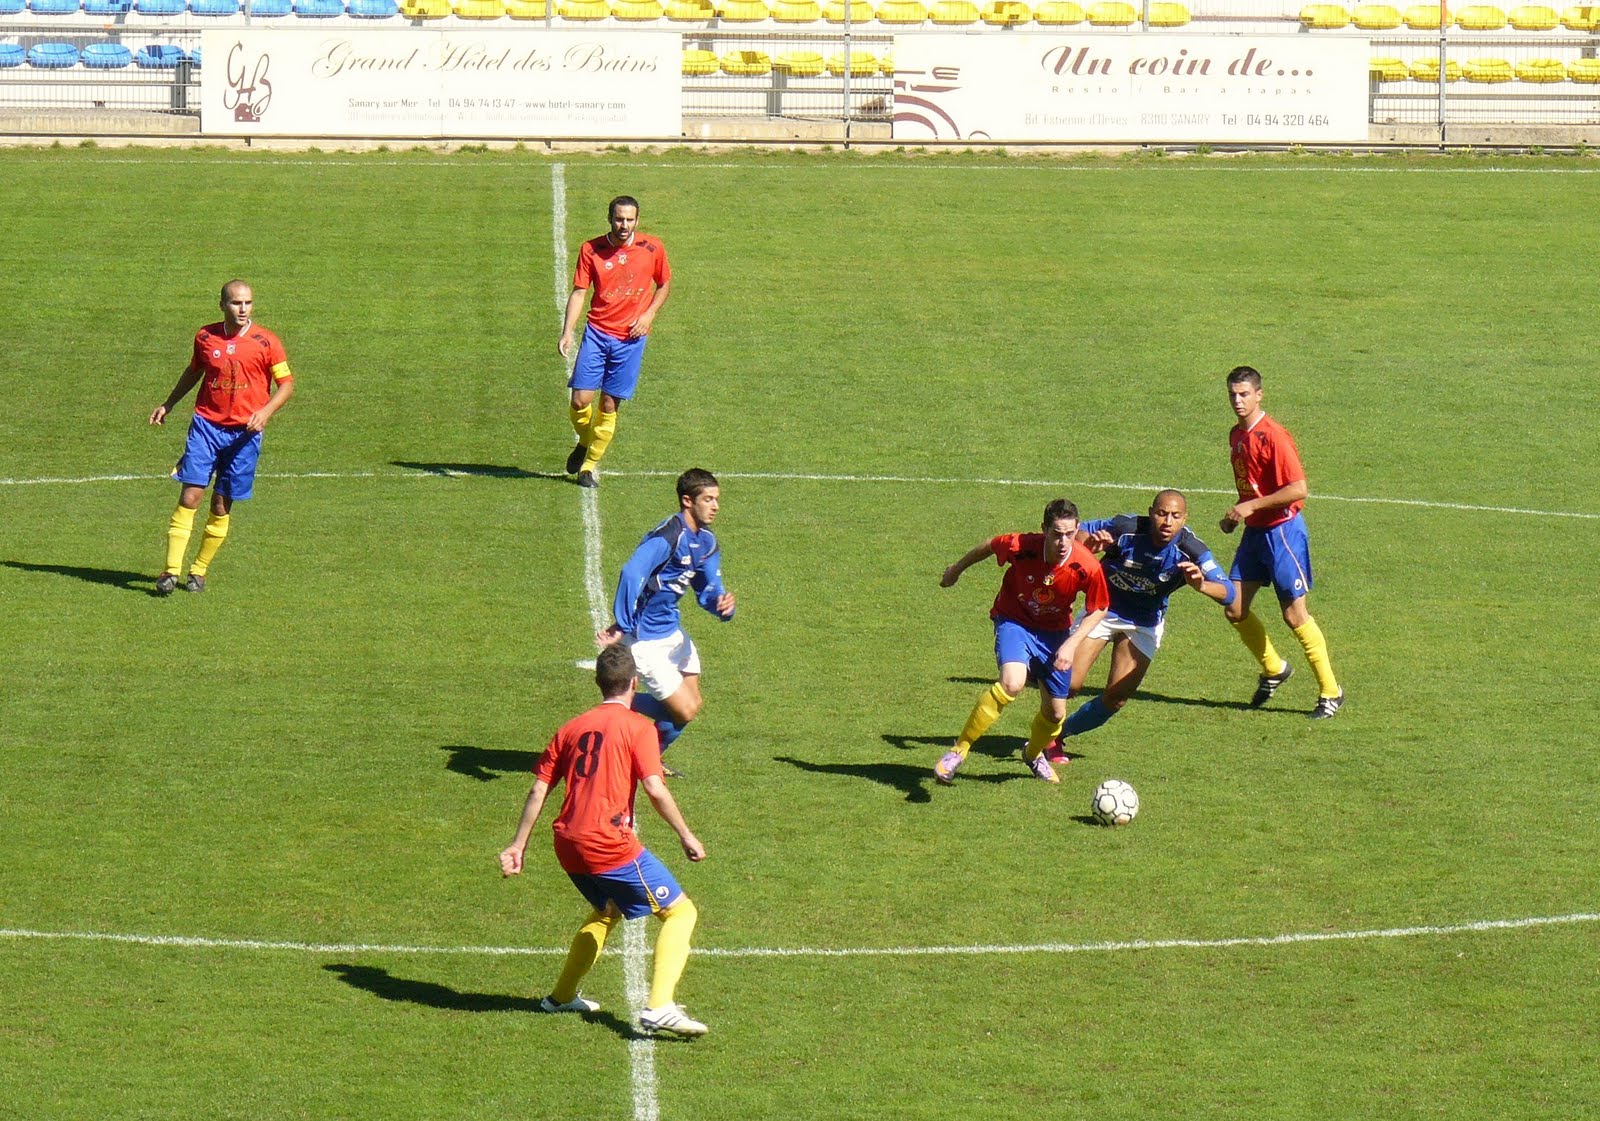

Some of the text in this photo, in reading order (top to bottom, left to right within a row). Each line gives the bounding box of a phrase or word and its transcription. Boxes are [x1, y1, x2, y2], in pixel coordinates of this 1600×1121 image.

[312, 39, 419, 78] Grand
[513, 49, 552, 72] des
[563, 41, 658, 72] Bains
[1042, 46, 1113, 76] Un
[1129, 48, 1214, 76] coin
[1164, 86, 1199, 94] Bar
[1248, 87, 1311, 95] tapas
[349, 98, 380, 109] Sanary
[383, 100, 398, 108] sur
[401, 98, 418, 108] Mer
[428, 98, 441, 108] Tel
[449, 98, 461, 108] 04
[464, 98, 475, 108] 94
[478, 98, 490, 108] 74
[492, 98, 501, 108] 13
[504, 98, 516, 108] 47
[1170, 113, 1210, 126] SANARY
[1222, 114, 1237, 126] Tel
[1246, 114, 1261, 126] 04
[1264, 114, 1279, 126] 94
[1283, 114, 1304, 126] 320
[1308, 114, 1330, 126] 464
[575, 730, 604, 778] 8
